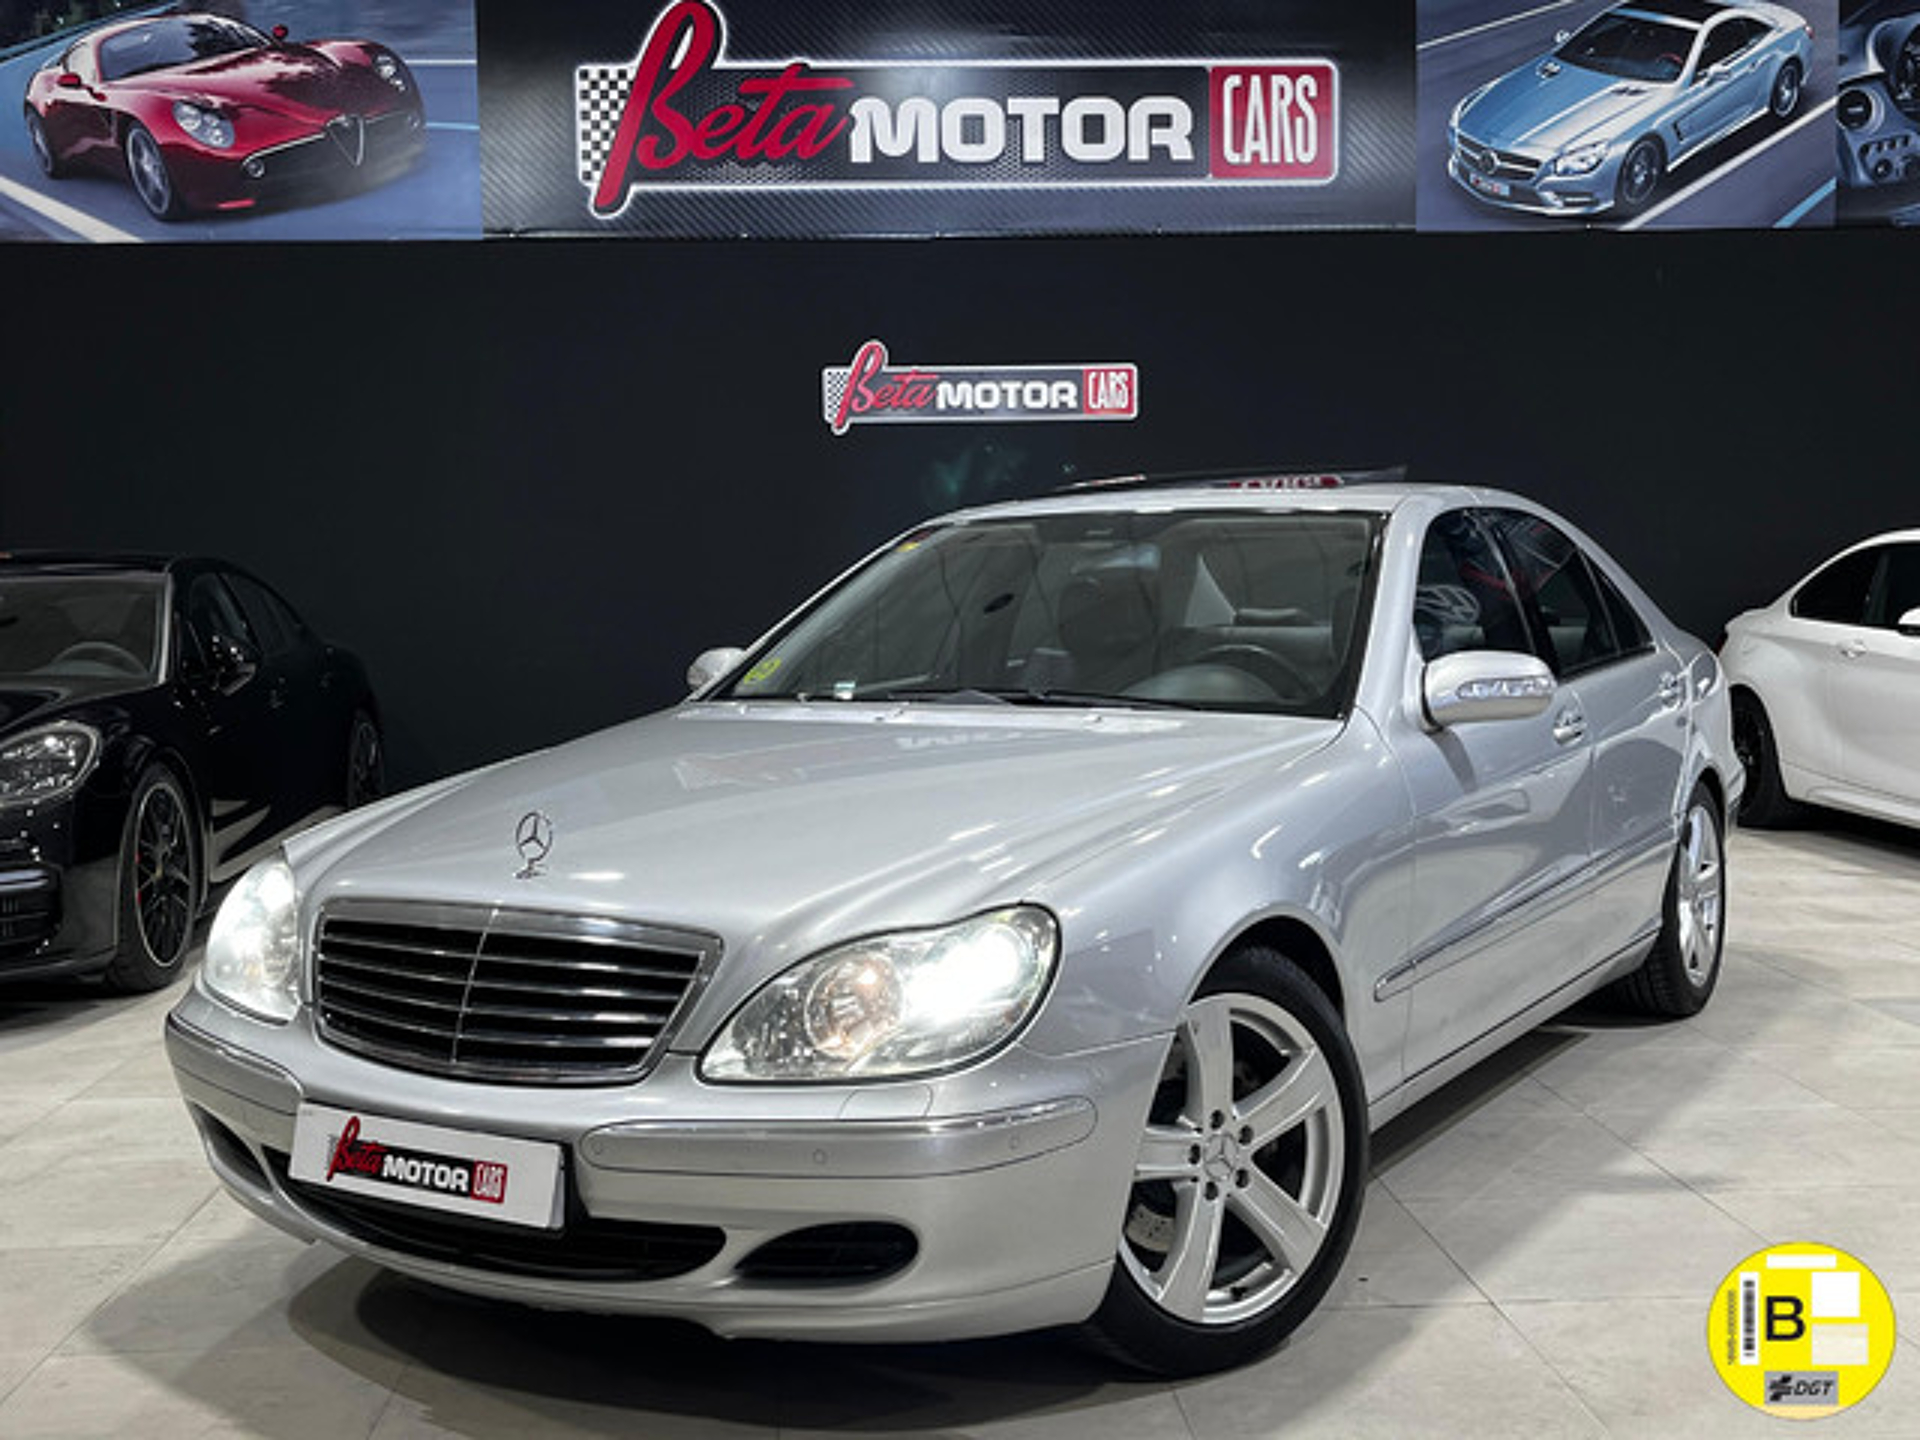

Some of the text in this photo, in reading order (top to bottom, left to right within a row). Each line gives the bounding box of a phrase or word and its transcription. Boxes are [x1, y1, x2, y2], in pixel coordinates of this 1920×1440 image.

[850, 96, 1194, 163] MOTOR
[1221, 73, 1318, 165] CARS
[936, 380, 1078, 410] MOTOR
[1087, 371, 1129, 409] CARS
[382, 1154, 470, 1192] MOTOR
